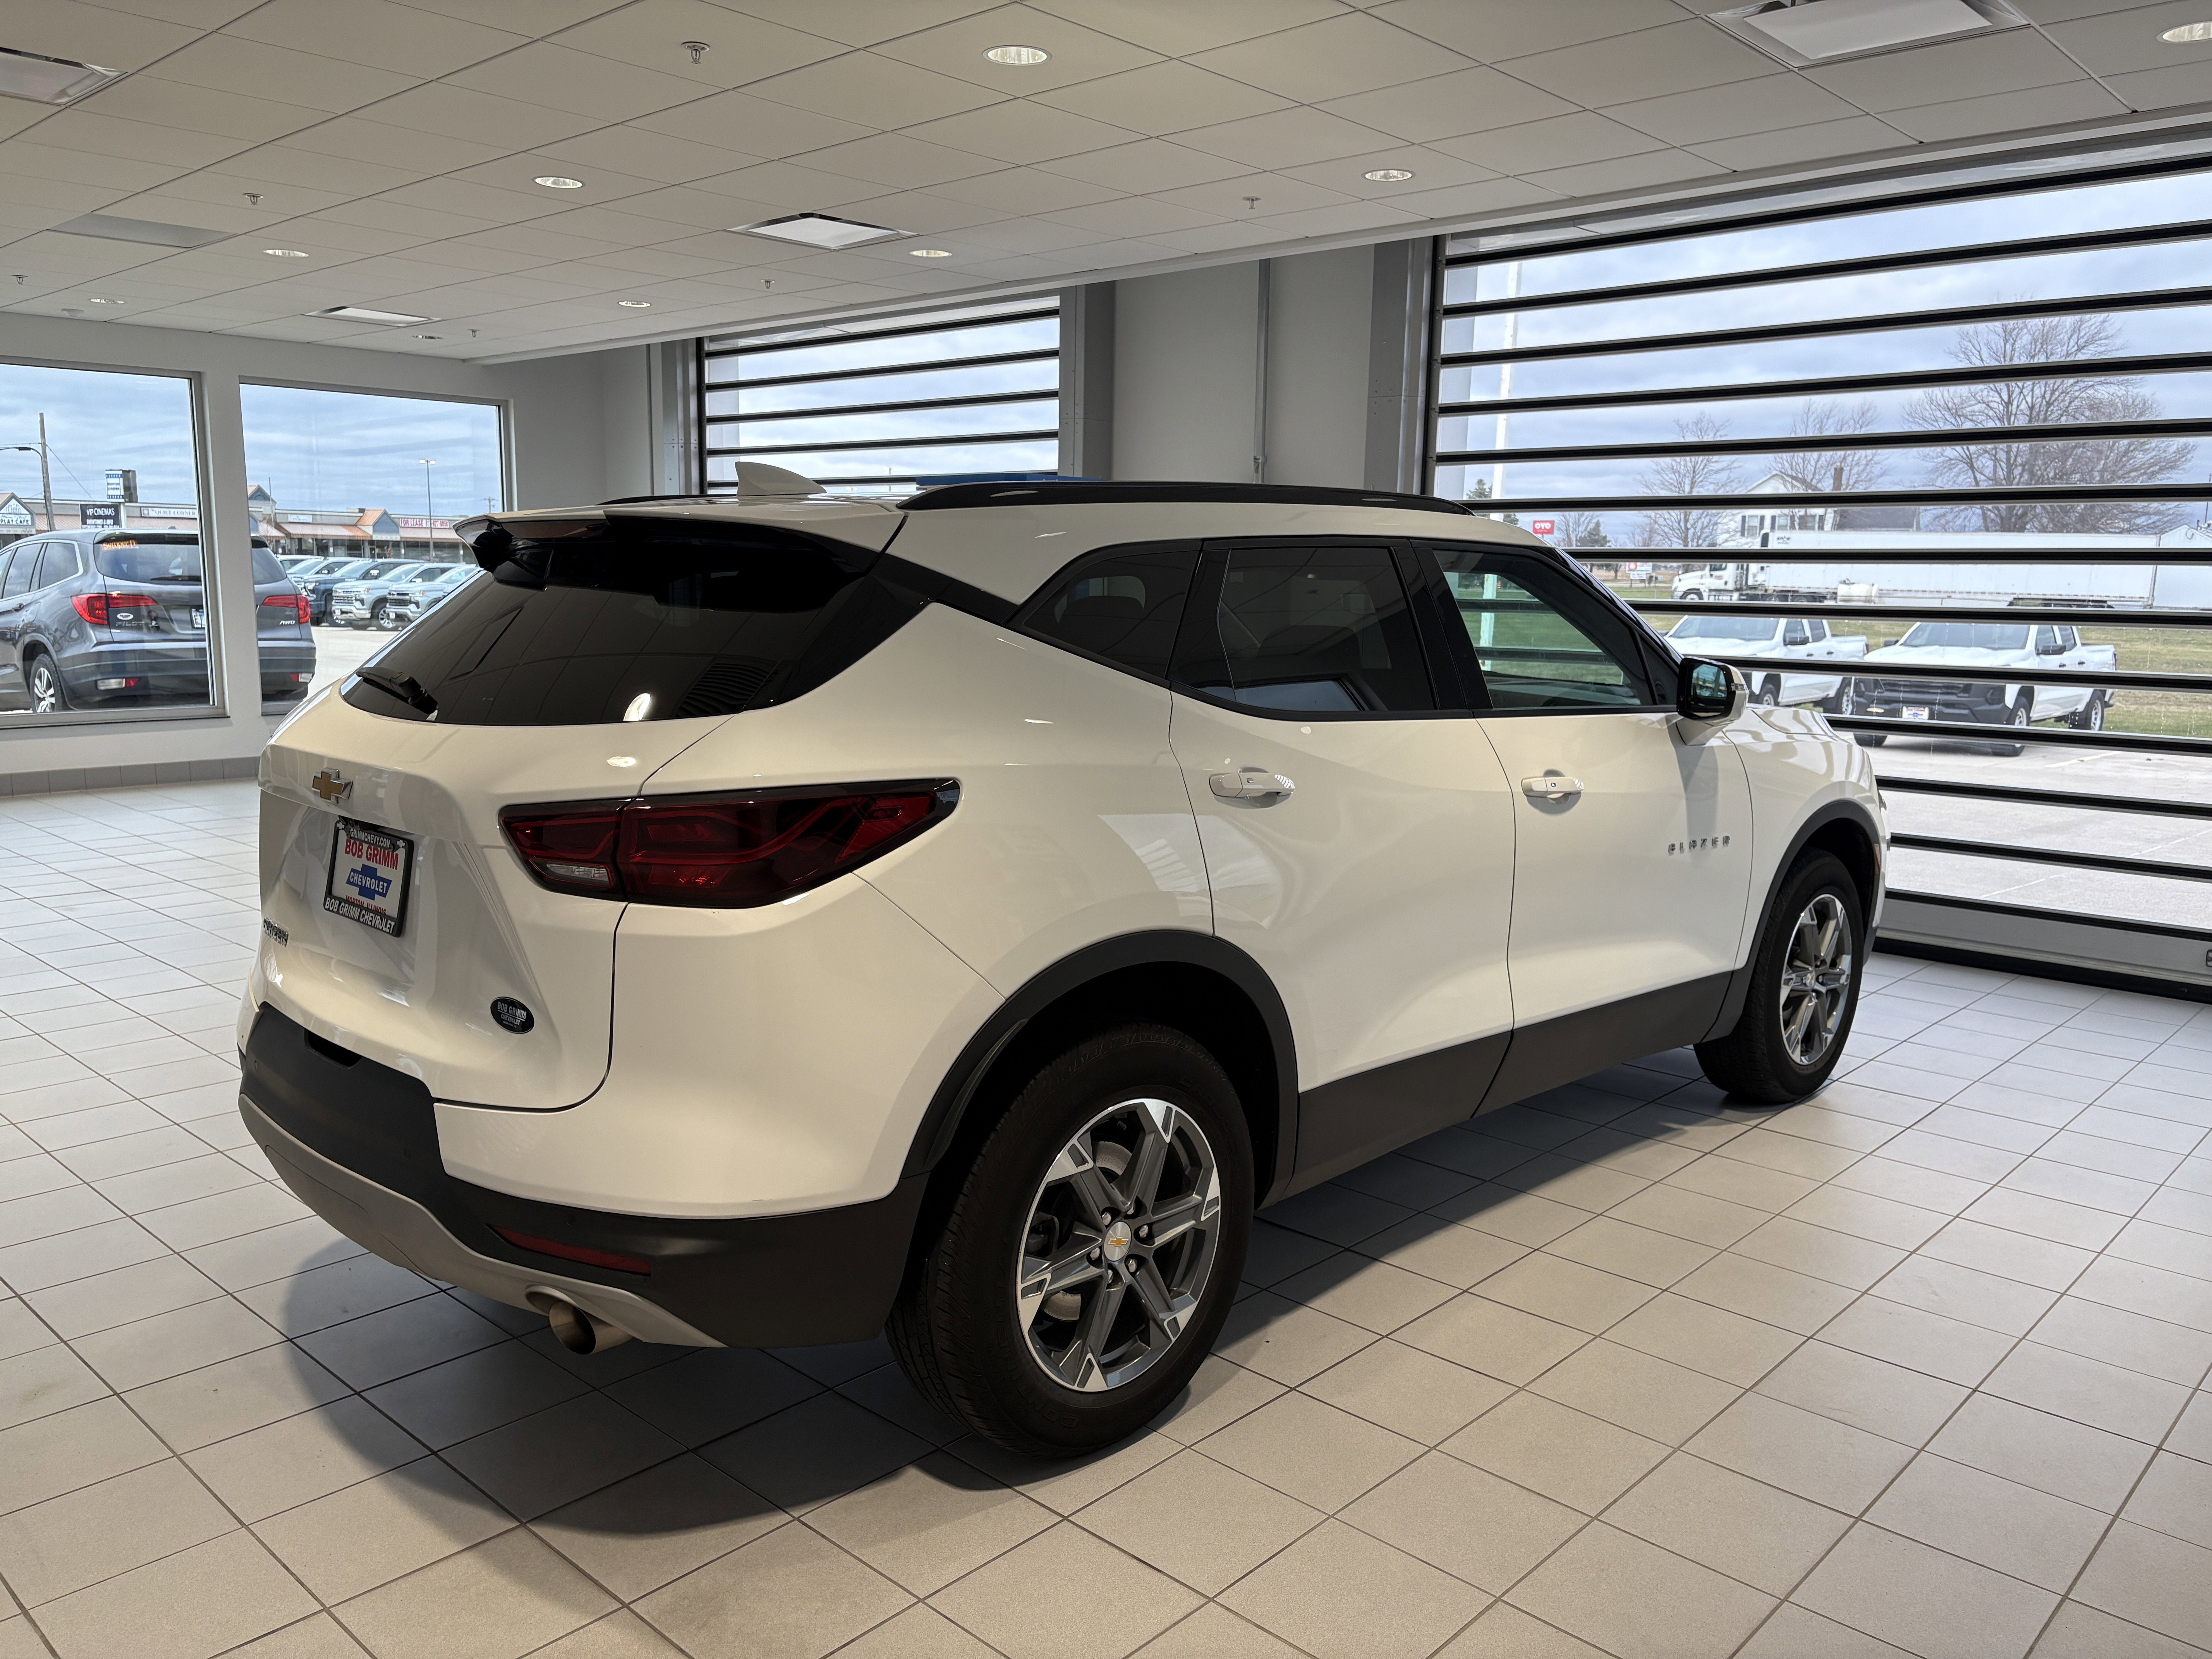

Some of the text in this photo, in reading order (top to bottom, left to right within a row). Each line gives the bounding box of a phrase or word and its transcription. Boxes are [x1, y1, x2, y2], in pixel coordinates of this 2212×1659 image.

[94, 508, 115, 516] CINEMAS
[350, 828, 391, 848] GRIMMCHEVY.COM
[1668, 836, 1730, 854] BLAZER
[345, 838, 399, 871] BOB GRIMM
[350, 872, 387, 893] CHEVROLET
[325, 897, 395, 934] BOB GRIMM CHEVROLET
[497, 1001, 527, 1020] BOB GRIMM
[501, 1013, 521, 1025] CHEVROLET
